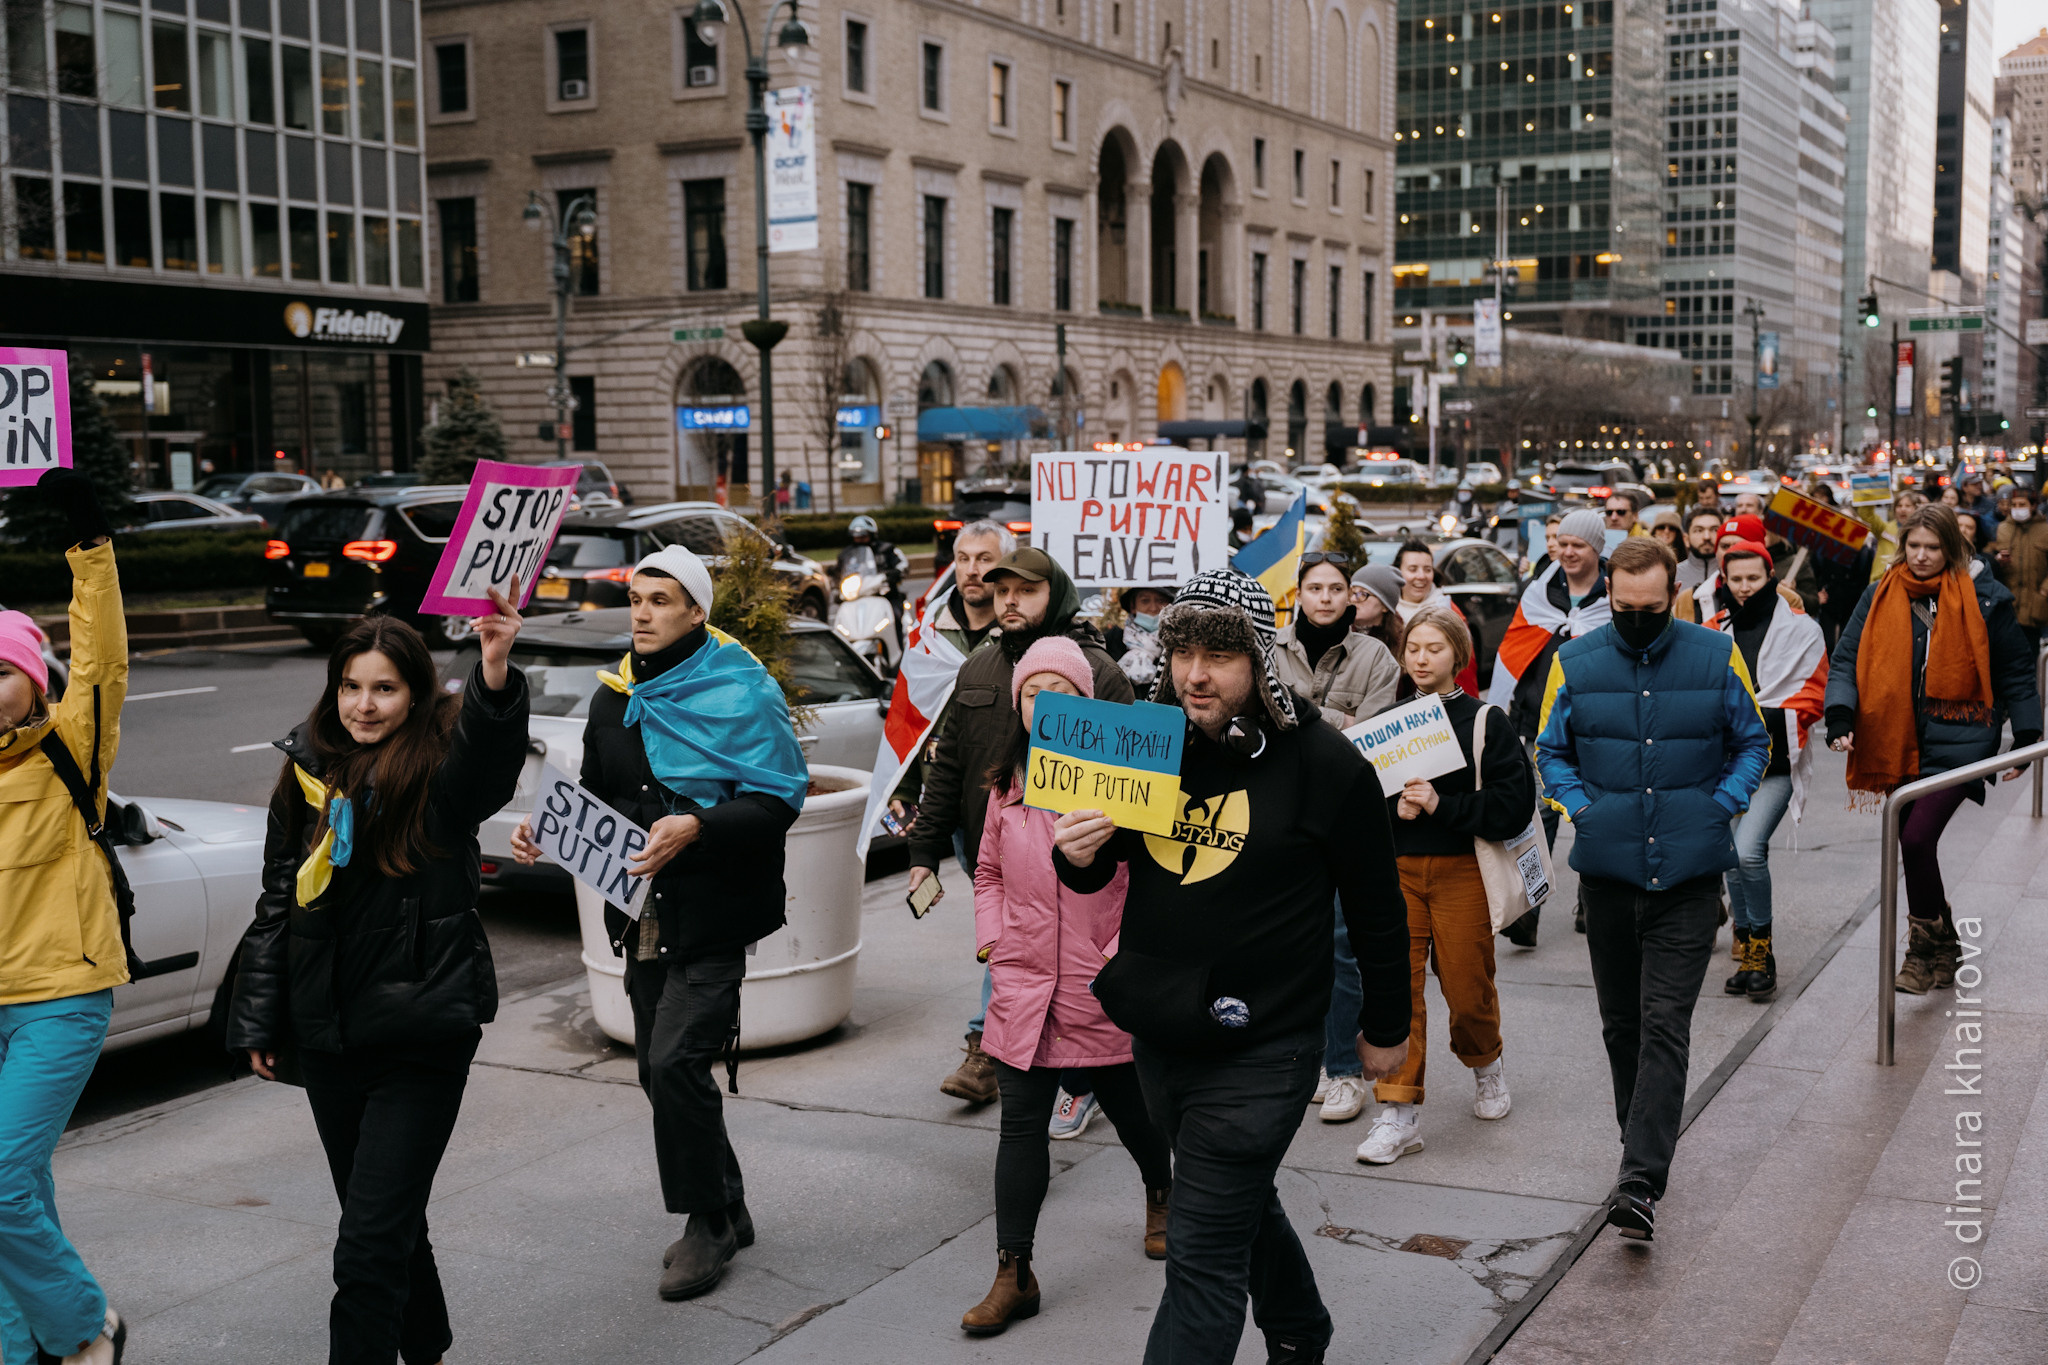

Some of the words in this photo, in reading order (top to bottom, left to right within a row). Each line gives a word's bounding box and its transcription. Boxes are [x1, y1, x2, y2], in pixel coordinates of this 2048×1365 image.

[313, 307, 405, 344] Fidelity
[1037, 461, 1076, 501] NO
[1084, 460, 1130, 499] TO
[1137, 454, 1222, 503] WAR!
[482, 488, 563, 533] STOP
[1080, 500, 1202, 542] PUTIN
[1038, 713, 1105, 755] СЛАВА
[1352, 719, 1404, 751] ПОШЛИ
[1407, 729, 1451, 756] СТРАНЫ
[1033, 755, 1084, 795] STOP
[1093, 772, 1151, 807] PUTIN
[546, 780, 646, 860] STOP
